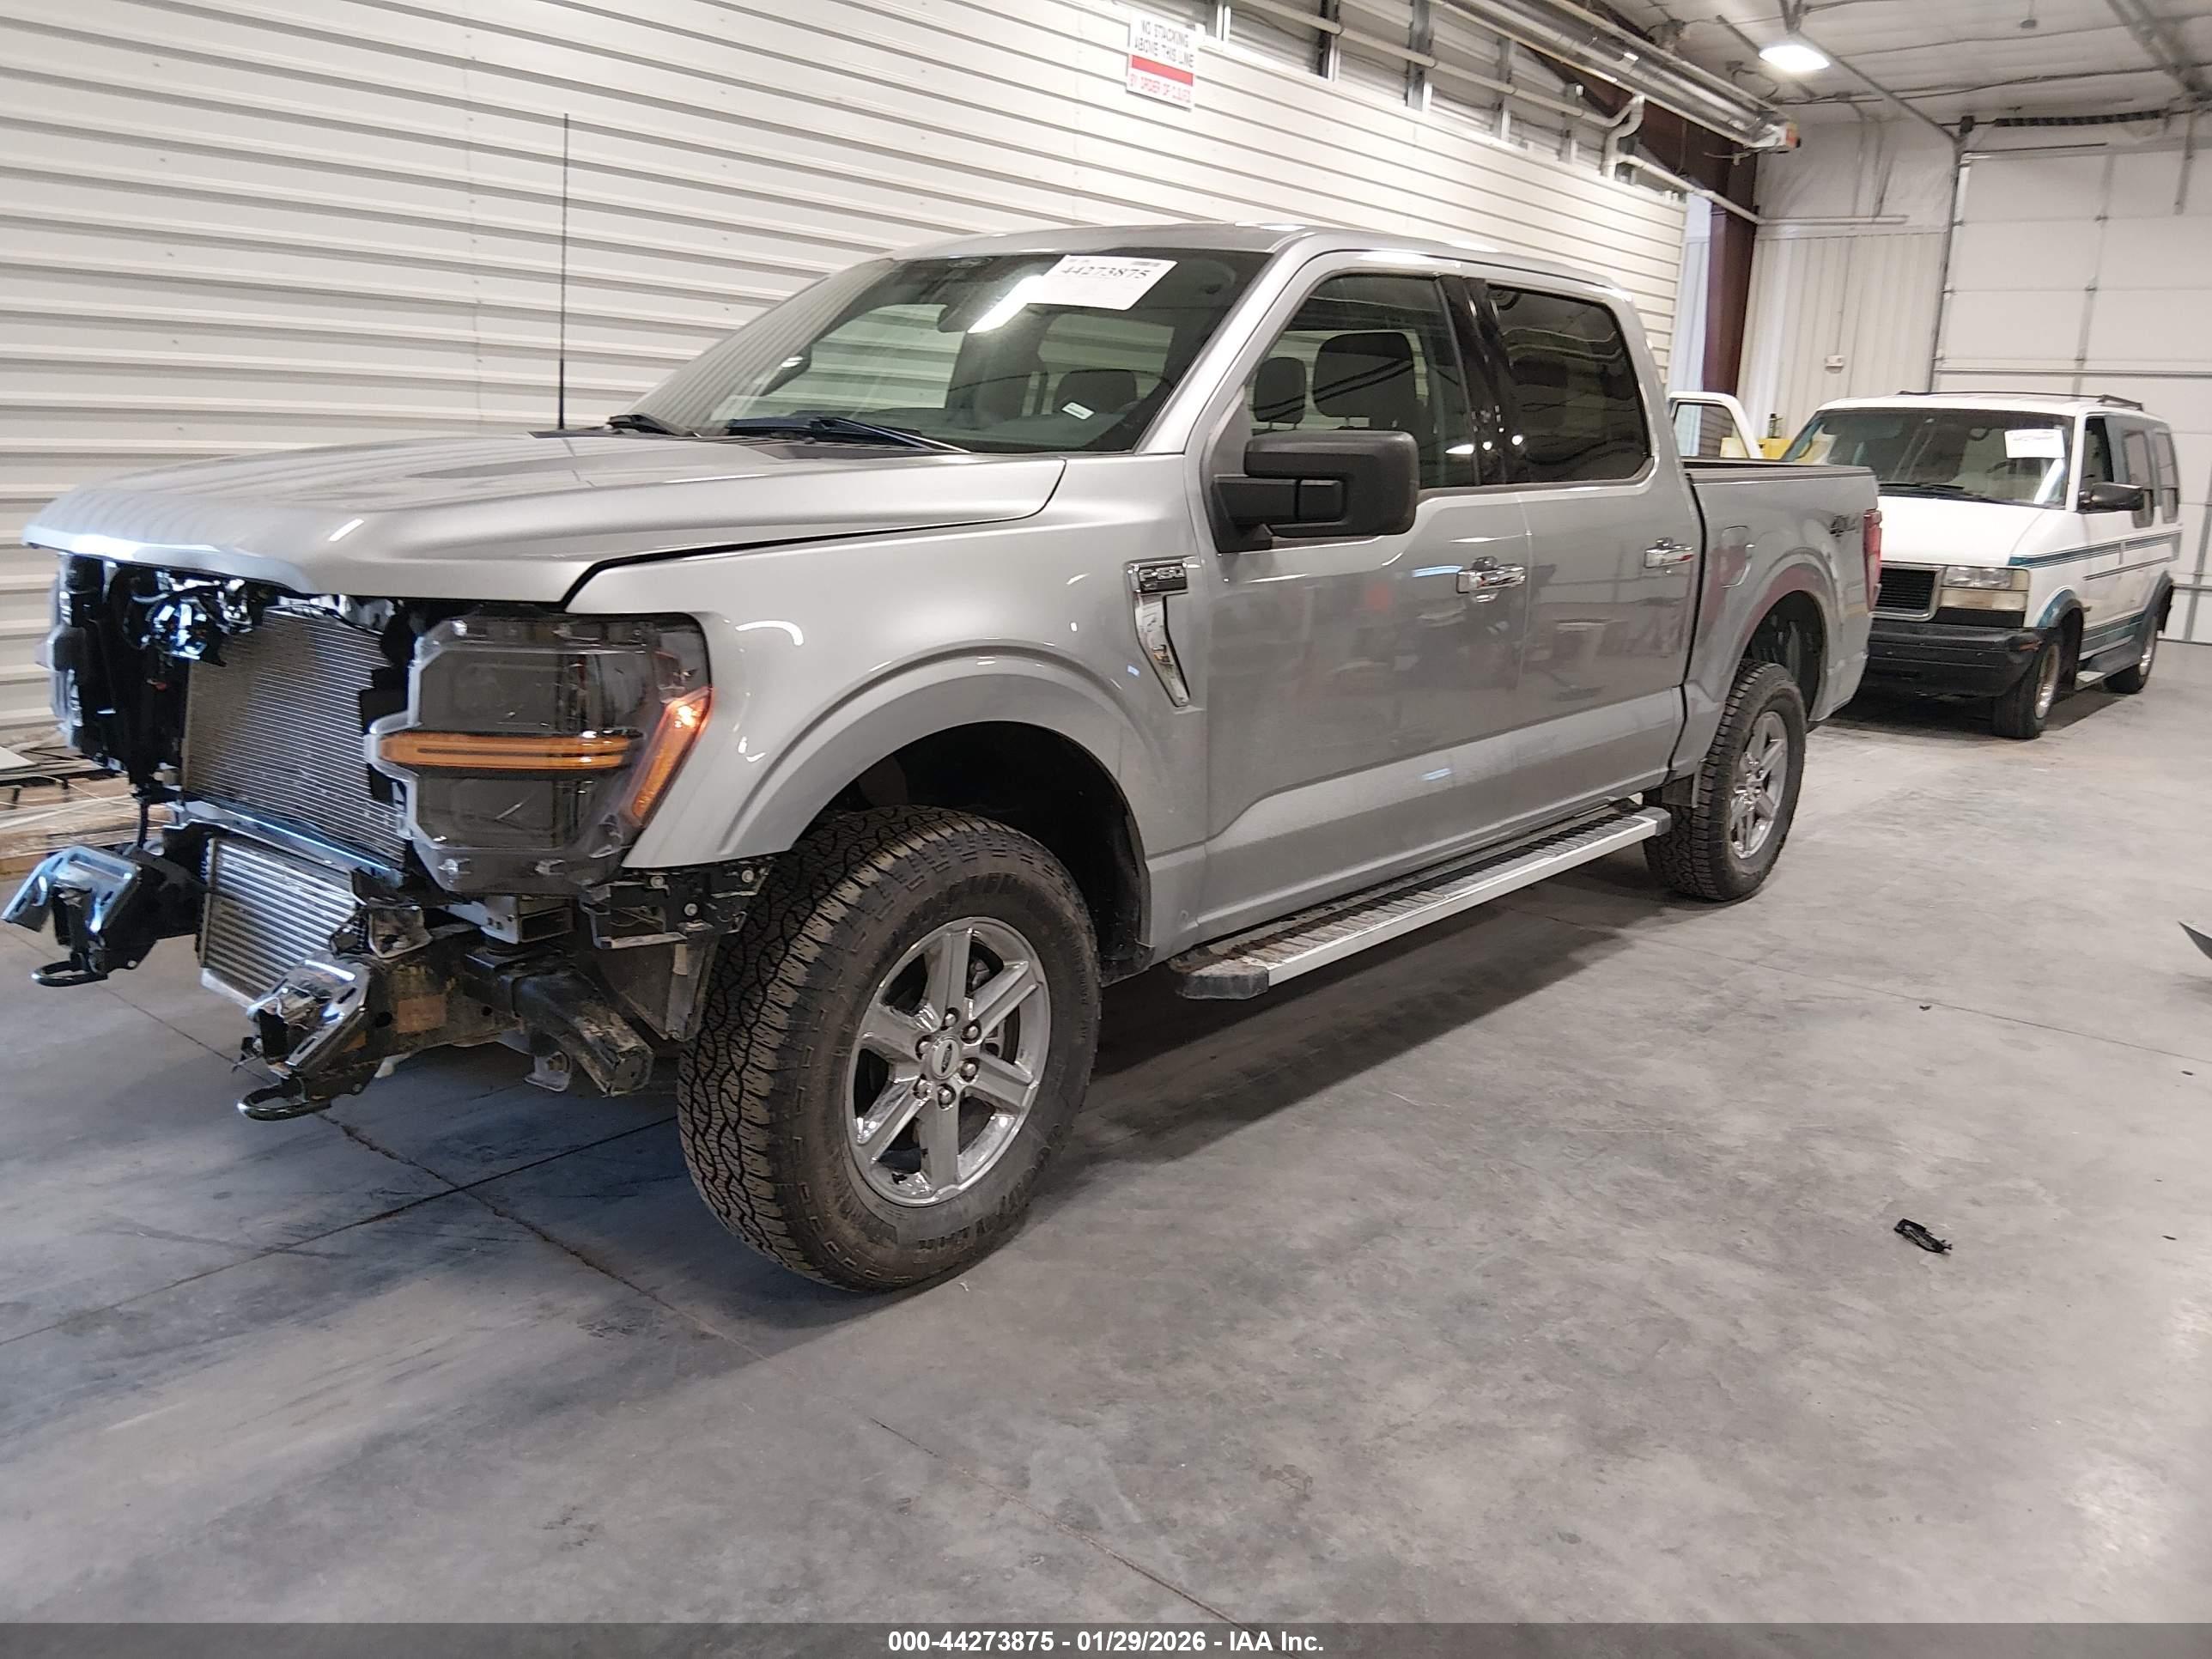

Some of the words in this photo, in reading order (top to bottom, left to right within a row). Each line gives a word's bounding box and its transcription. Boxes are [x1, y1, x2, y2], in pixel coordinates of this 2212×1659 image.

[1141, 20, 1151, 35] NO
[1154, 24, 1188, 48] STACKING
[1134, 36, 1158, 57] ABOVE
[1161, 44, 1176, 62] THIS
[1178, 51, 1194, 69] LINE
[1060, 265, 1152, 279] 44273875
